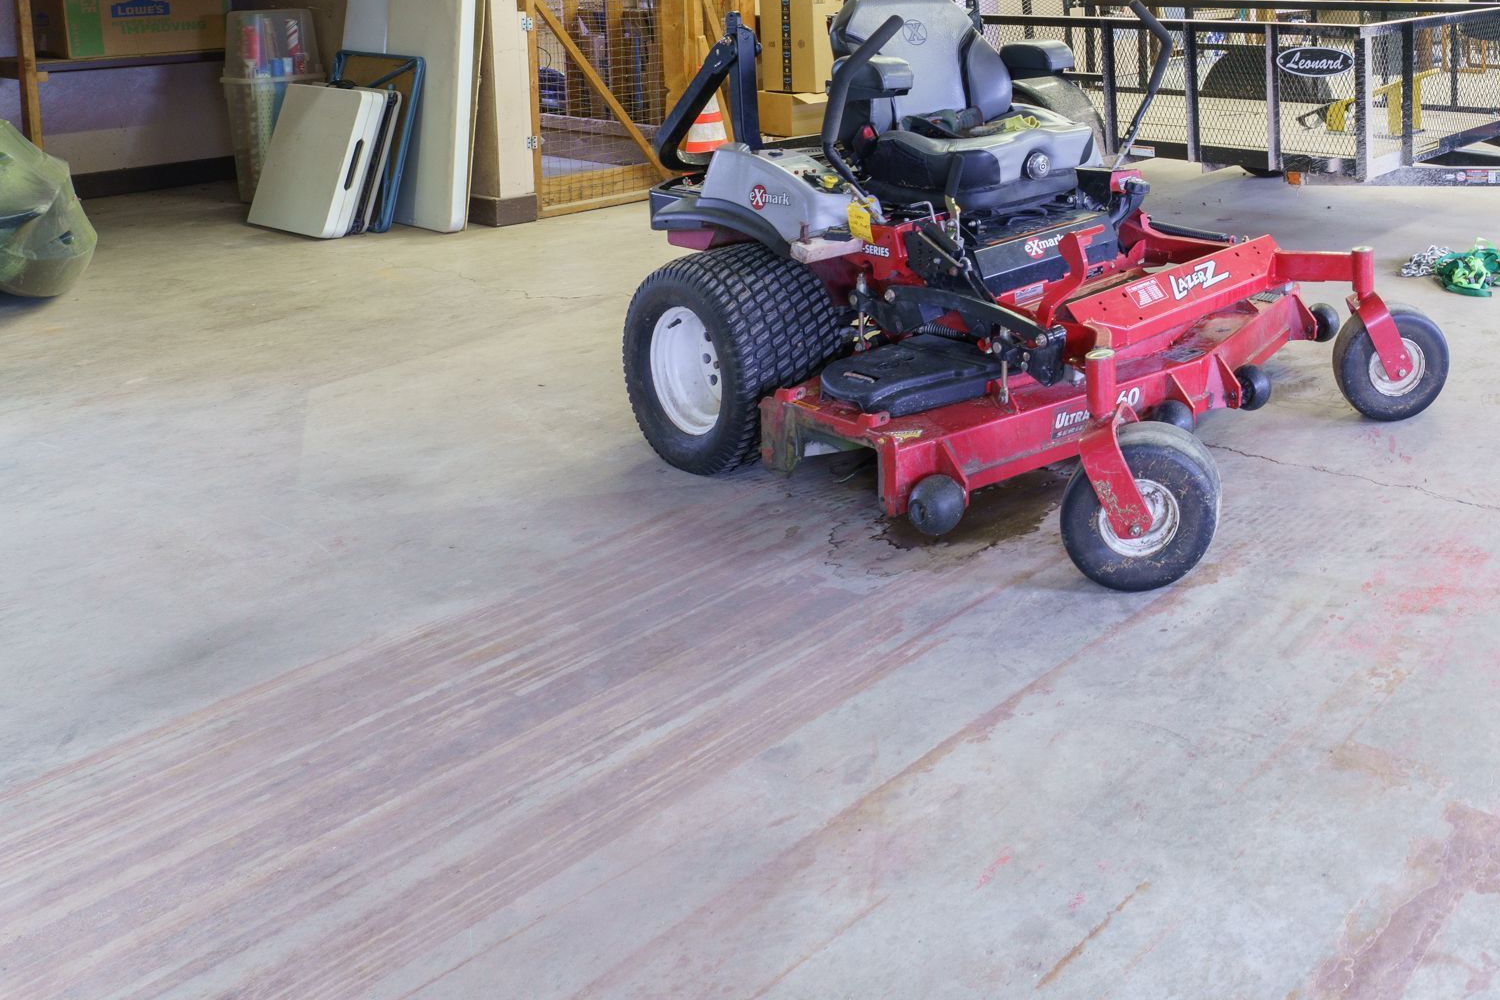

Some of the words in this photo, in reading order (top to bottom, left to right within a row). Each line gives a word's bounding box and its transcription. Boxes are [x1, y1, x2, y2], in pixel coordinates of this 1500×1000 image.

[117, 4, 165, 16] LOWE'S
[1285, 51, 1344, 70] Leonard
[749, 188, 791, 207] eXmark
[861, 243, 890, 258] -SERIES
[1055, 409, 1091, 430] ULTRA
